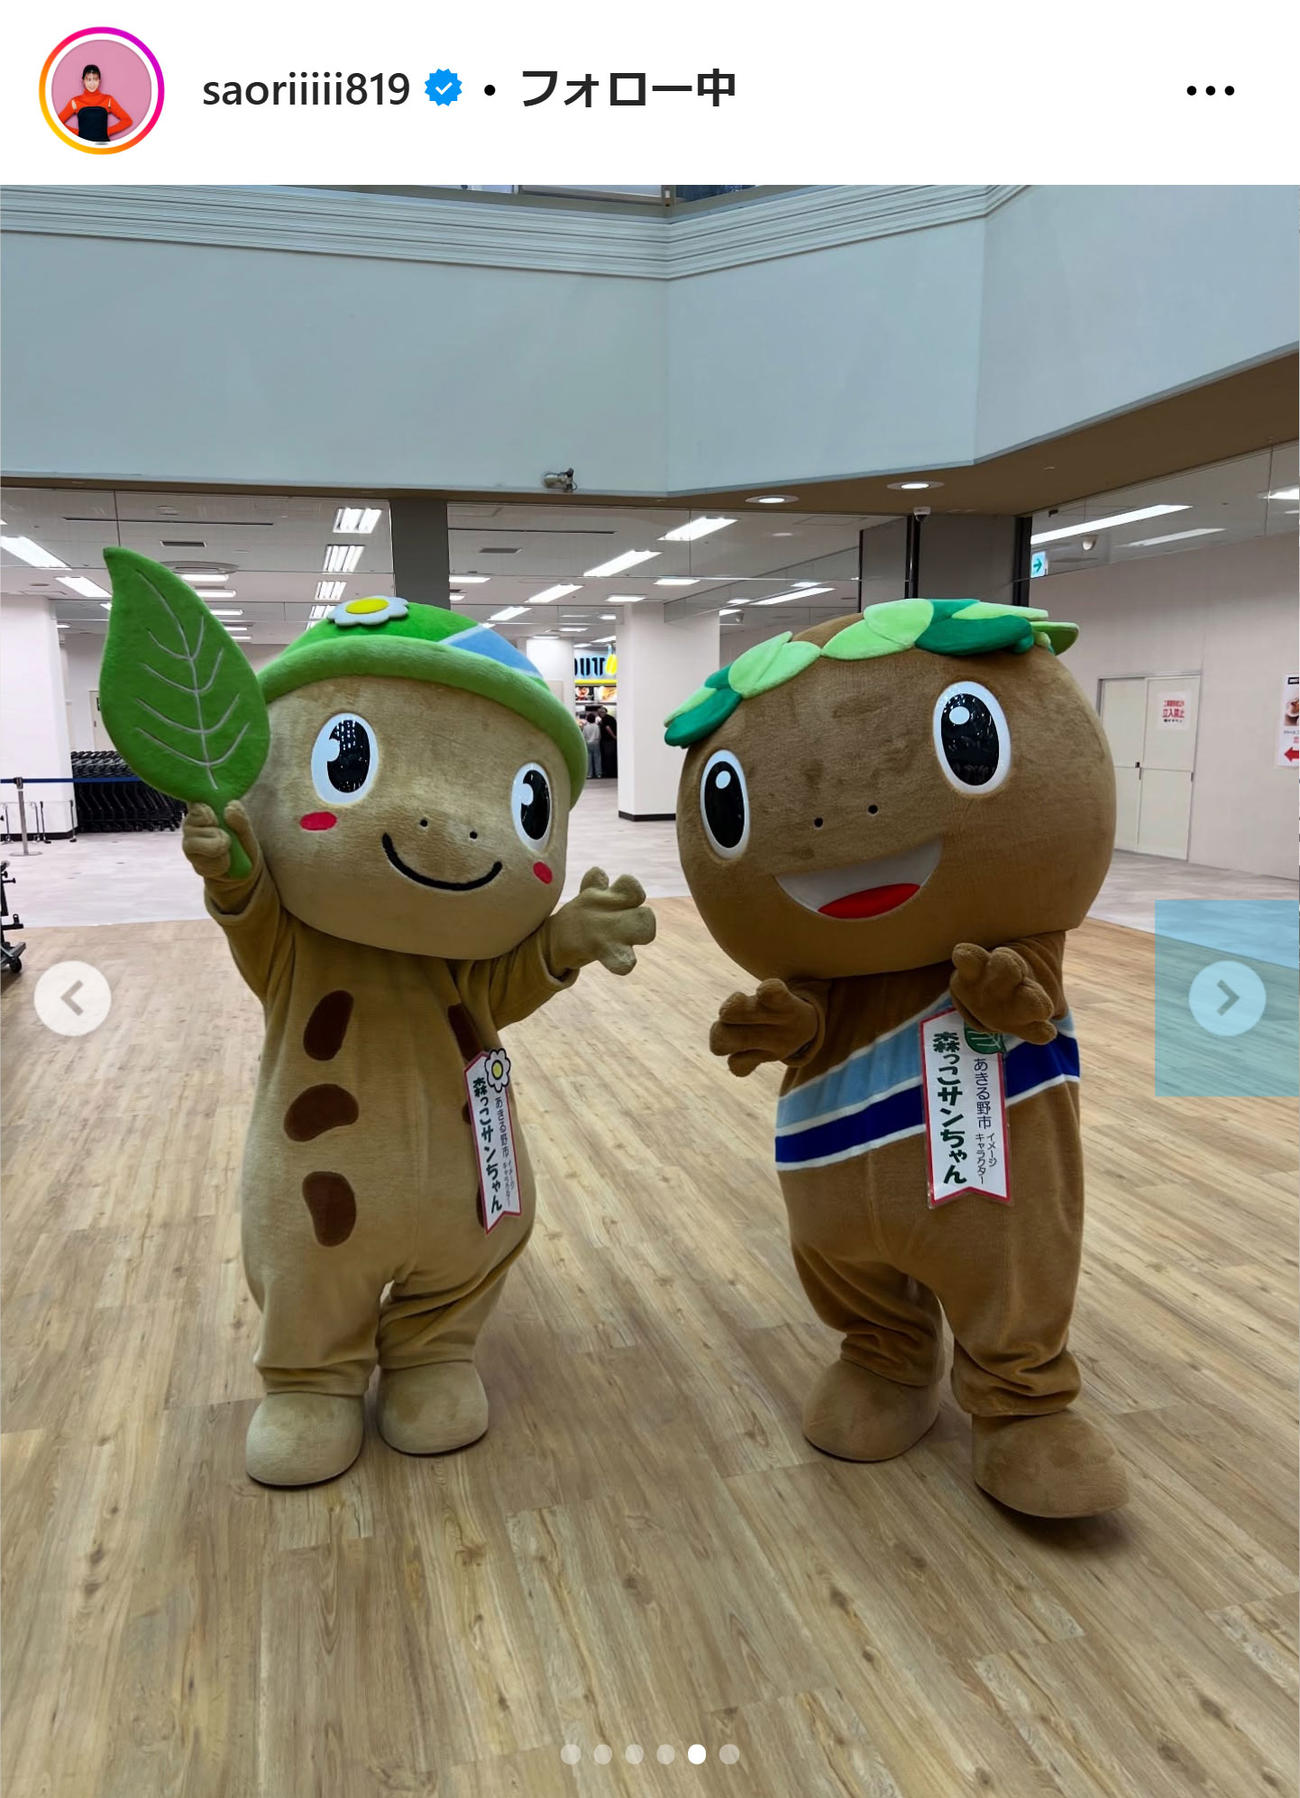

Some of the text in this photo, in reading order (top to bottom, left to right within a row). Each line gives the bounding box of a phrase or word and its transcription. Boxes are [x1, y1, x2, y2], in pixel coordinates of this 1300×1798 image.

[933, 1031, 968, 1185] 森っこサンちゃん
[974, 1058, 992, 1130] あきる野市
[472, 1077, 503, 1214] 森っこサンちゃん
[975, 1133, 987, 1185] キャラクター
[987, 1132, 997, 1168] イメージ
